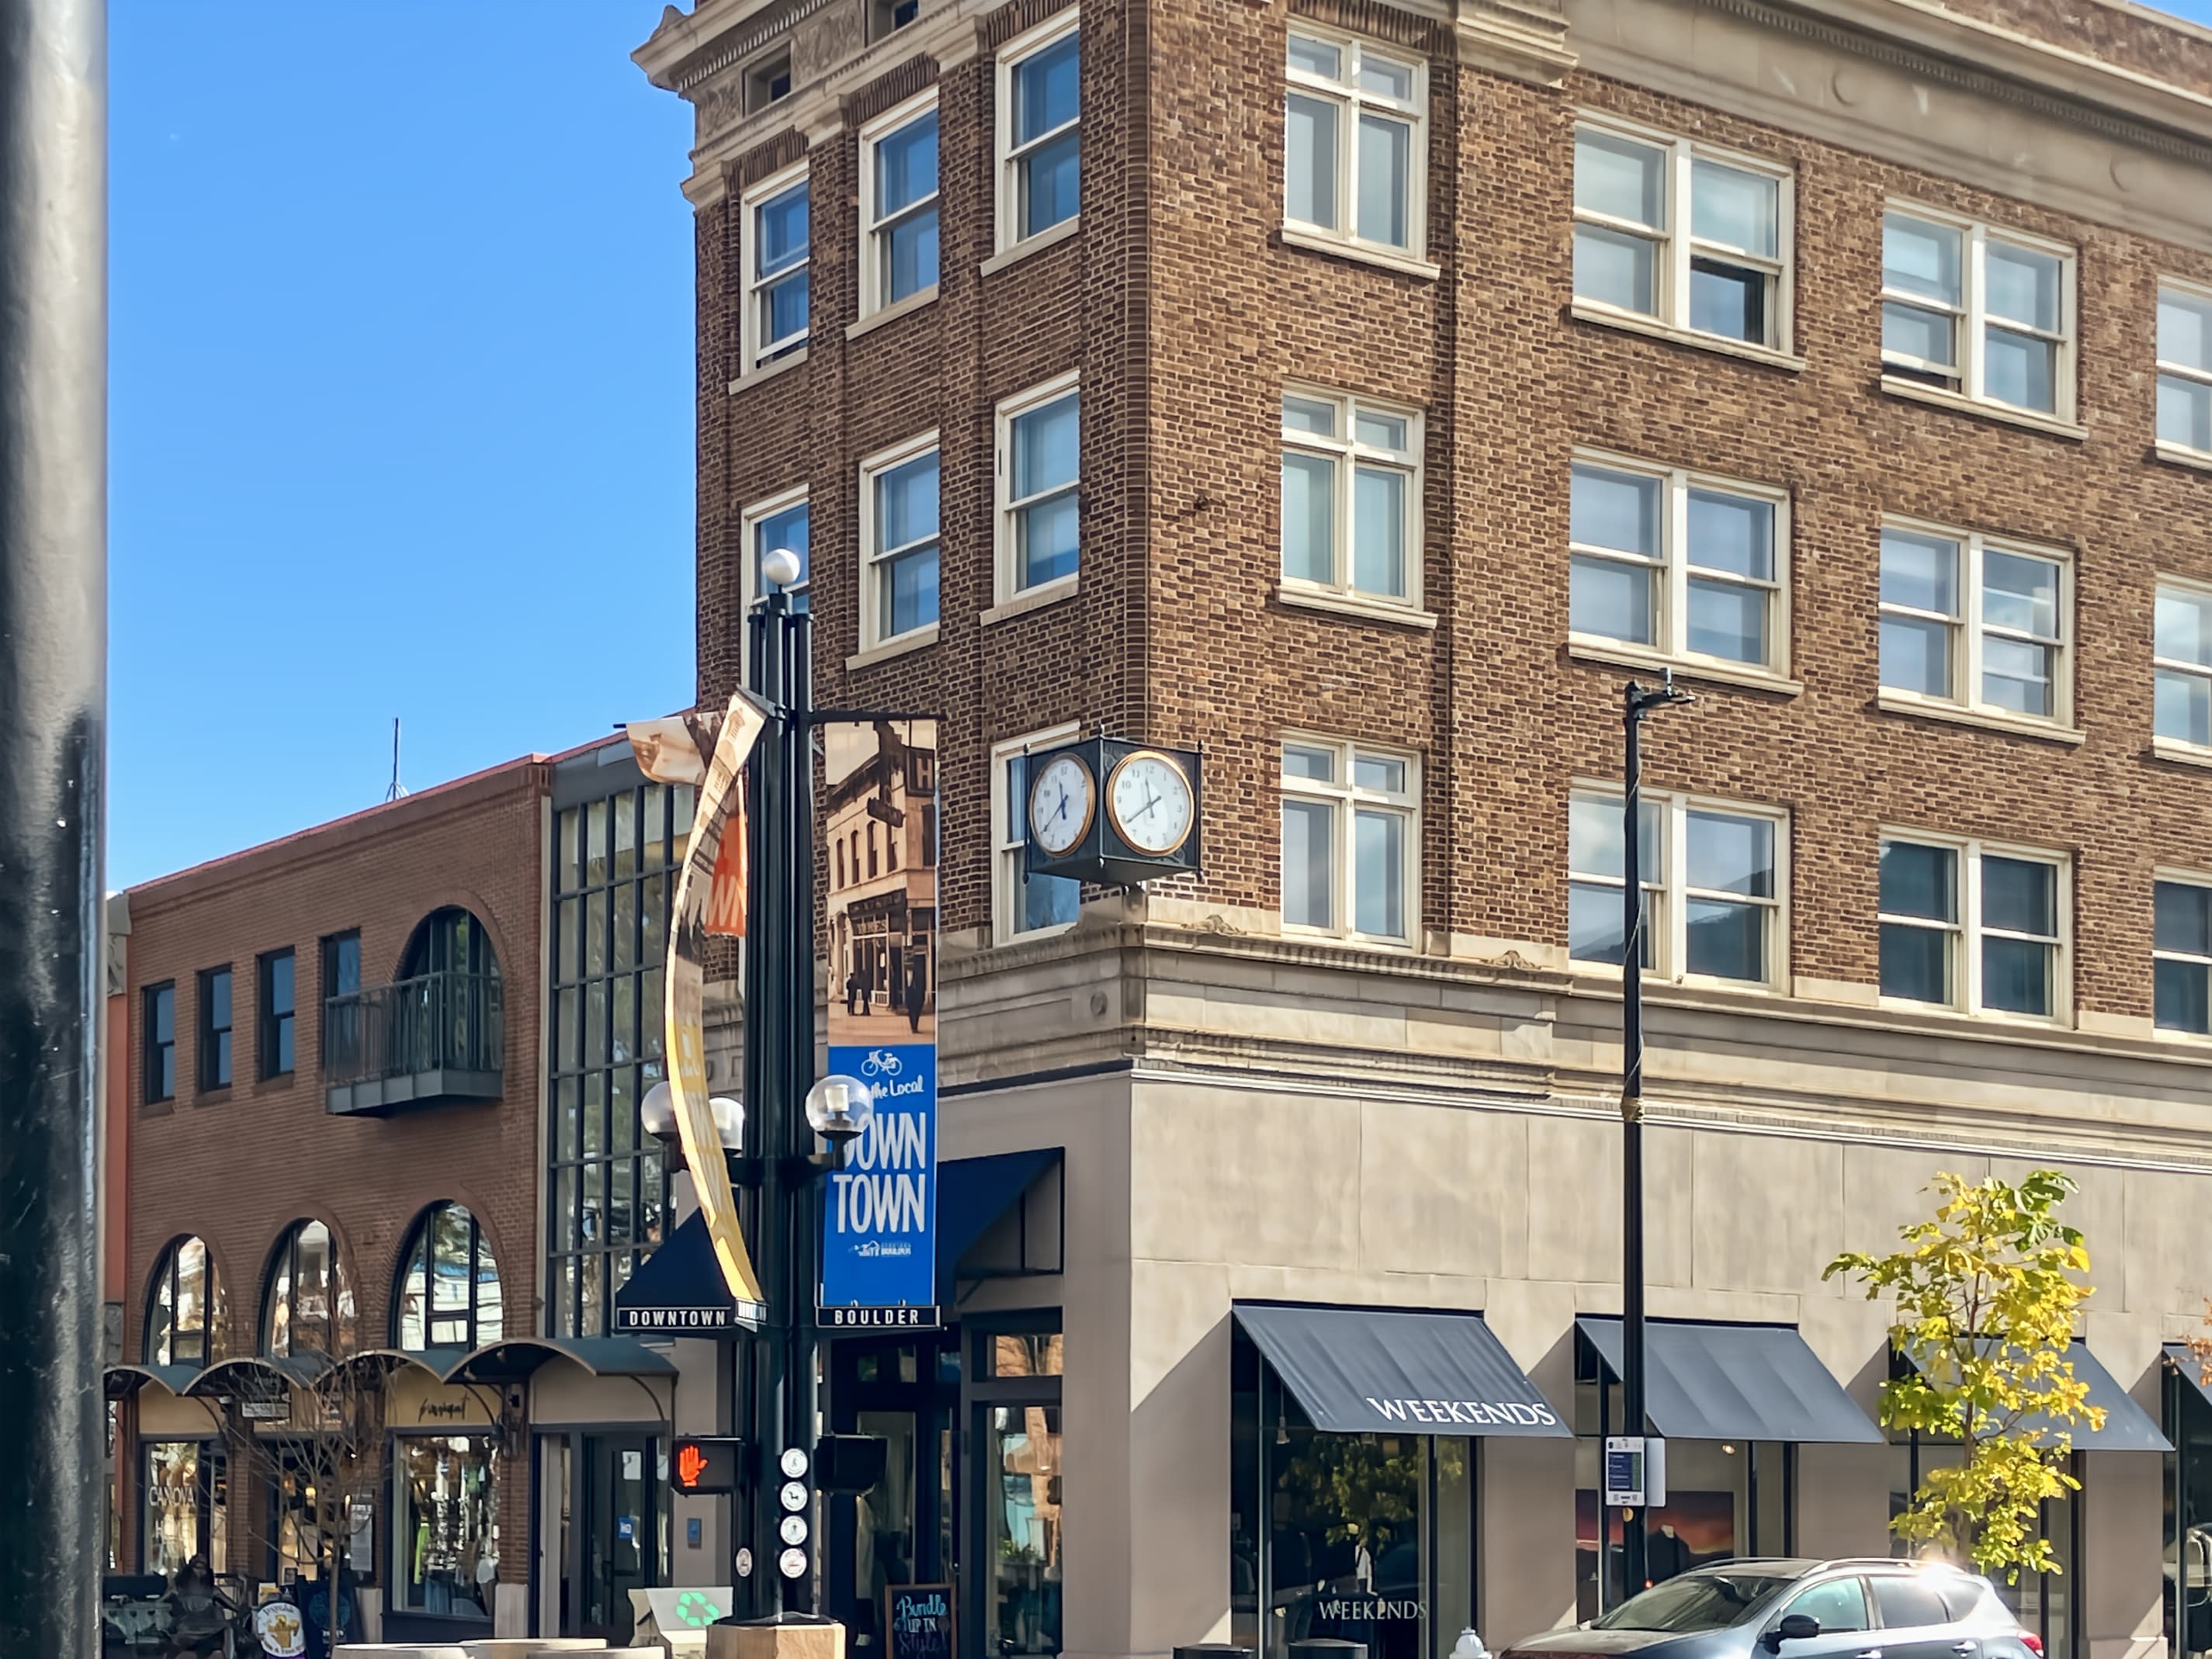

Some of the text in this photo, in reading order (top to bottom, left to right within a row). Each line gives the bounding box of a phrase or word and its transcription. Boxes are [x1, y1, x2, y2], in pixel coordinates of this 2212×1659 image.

[889, 1074, 925, 1096] Local
[832, 1173, 927, 1234] TOWN
[629, 1311, 726, 1327] DOWNTOWN
[834, 1309, 919, 1325] BOULDER
[1365, 1398, 1557, 1426] WEEKENDS
[1319, 1601, 1427, 1620] WEEKENDS
[907, 1618, 921, 1633] UP
